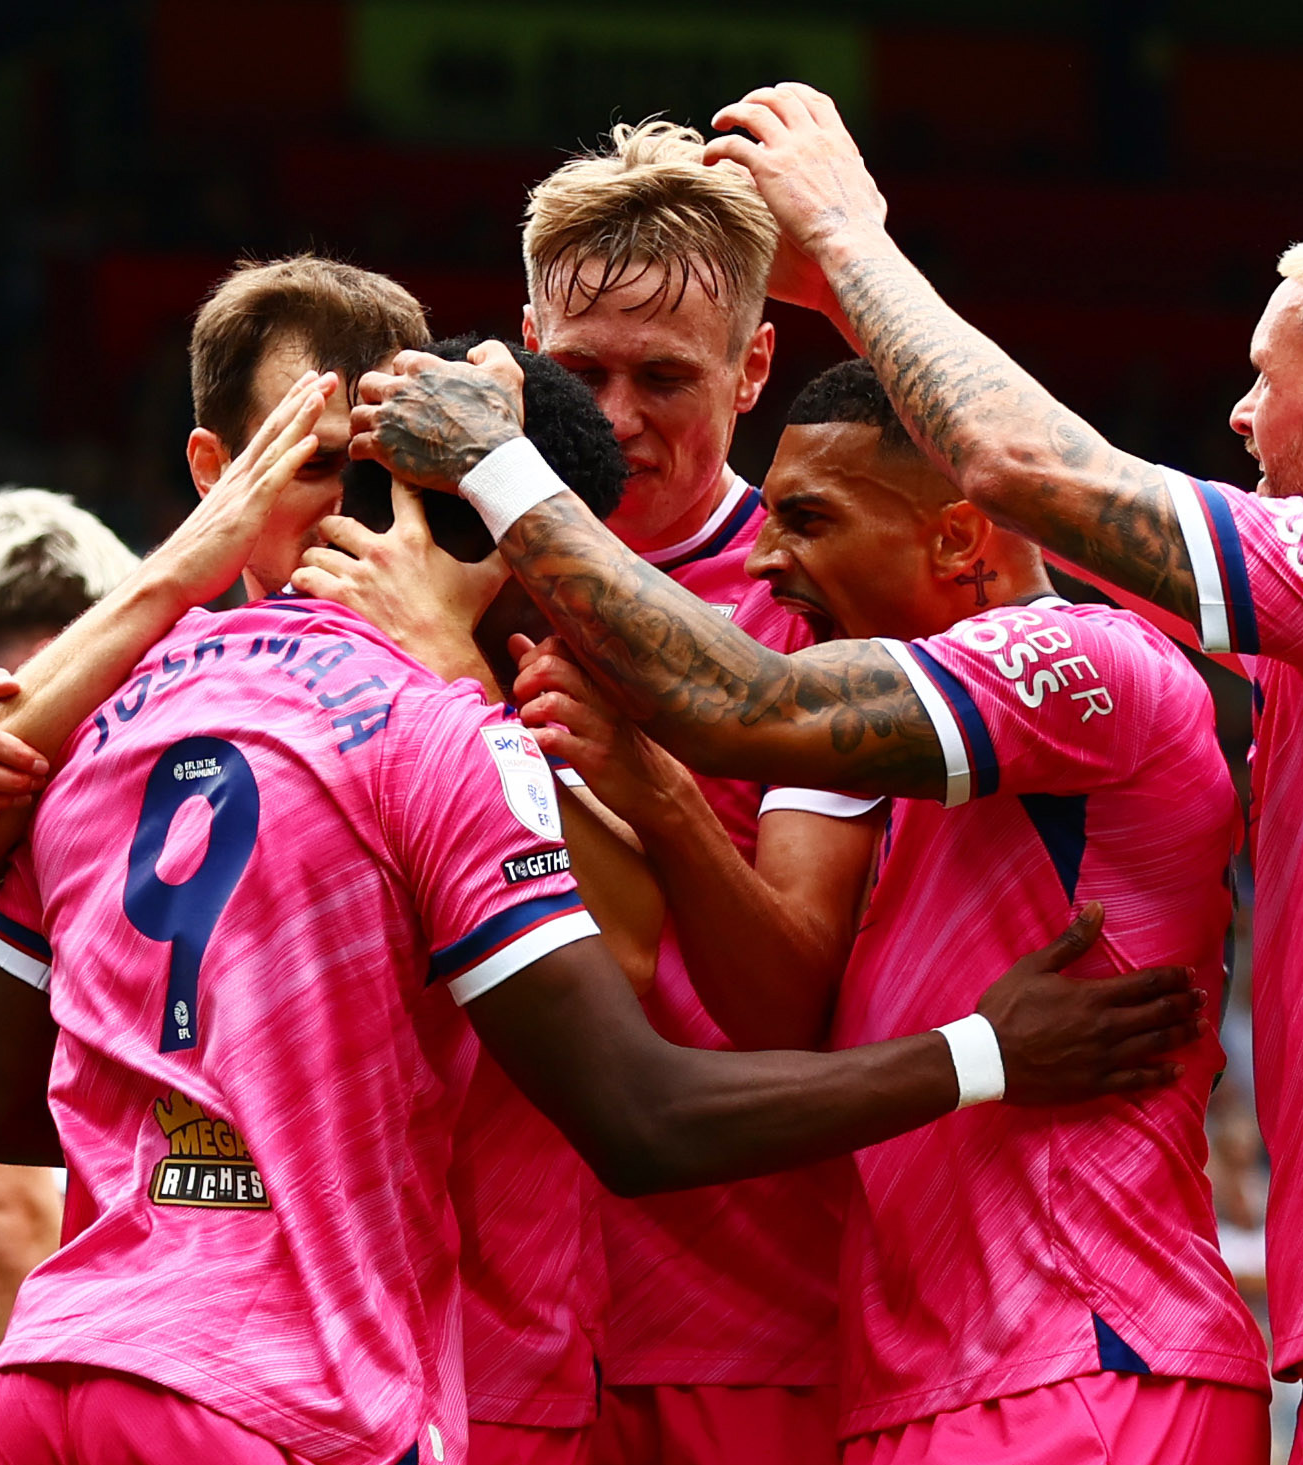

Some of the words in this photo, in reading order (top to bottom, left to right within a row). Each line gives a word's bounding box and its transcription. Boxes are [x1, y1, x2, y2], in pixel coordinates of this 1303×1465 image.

[242, 636, 391, 755] MAJA
[123, 735, 261, 1054] 9
[177, 1027, 192, 1041] EFL
[169, 1120, 250, 1158] MEGA
[161, 1166, 265, 1201] RICHES
